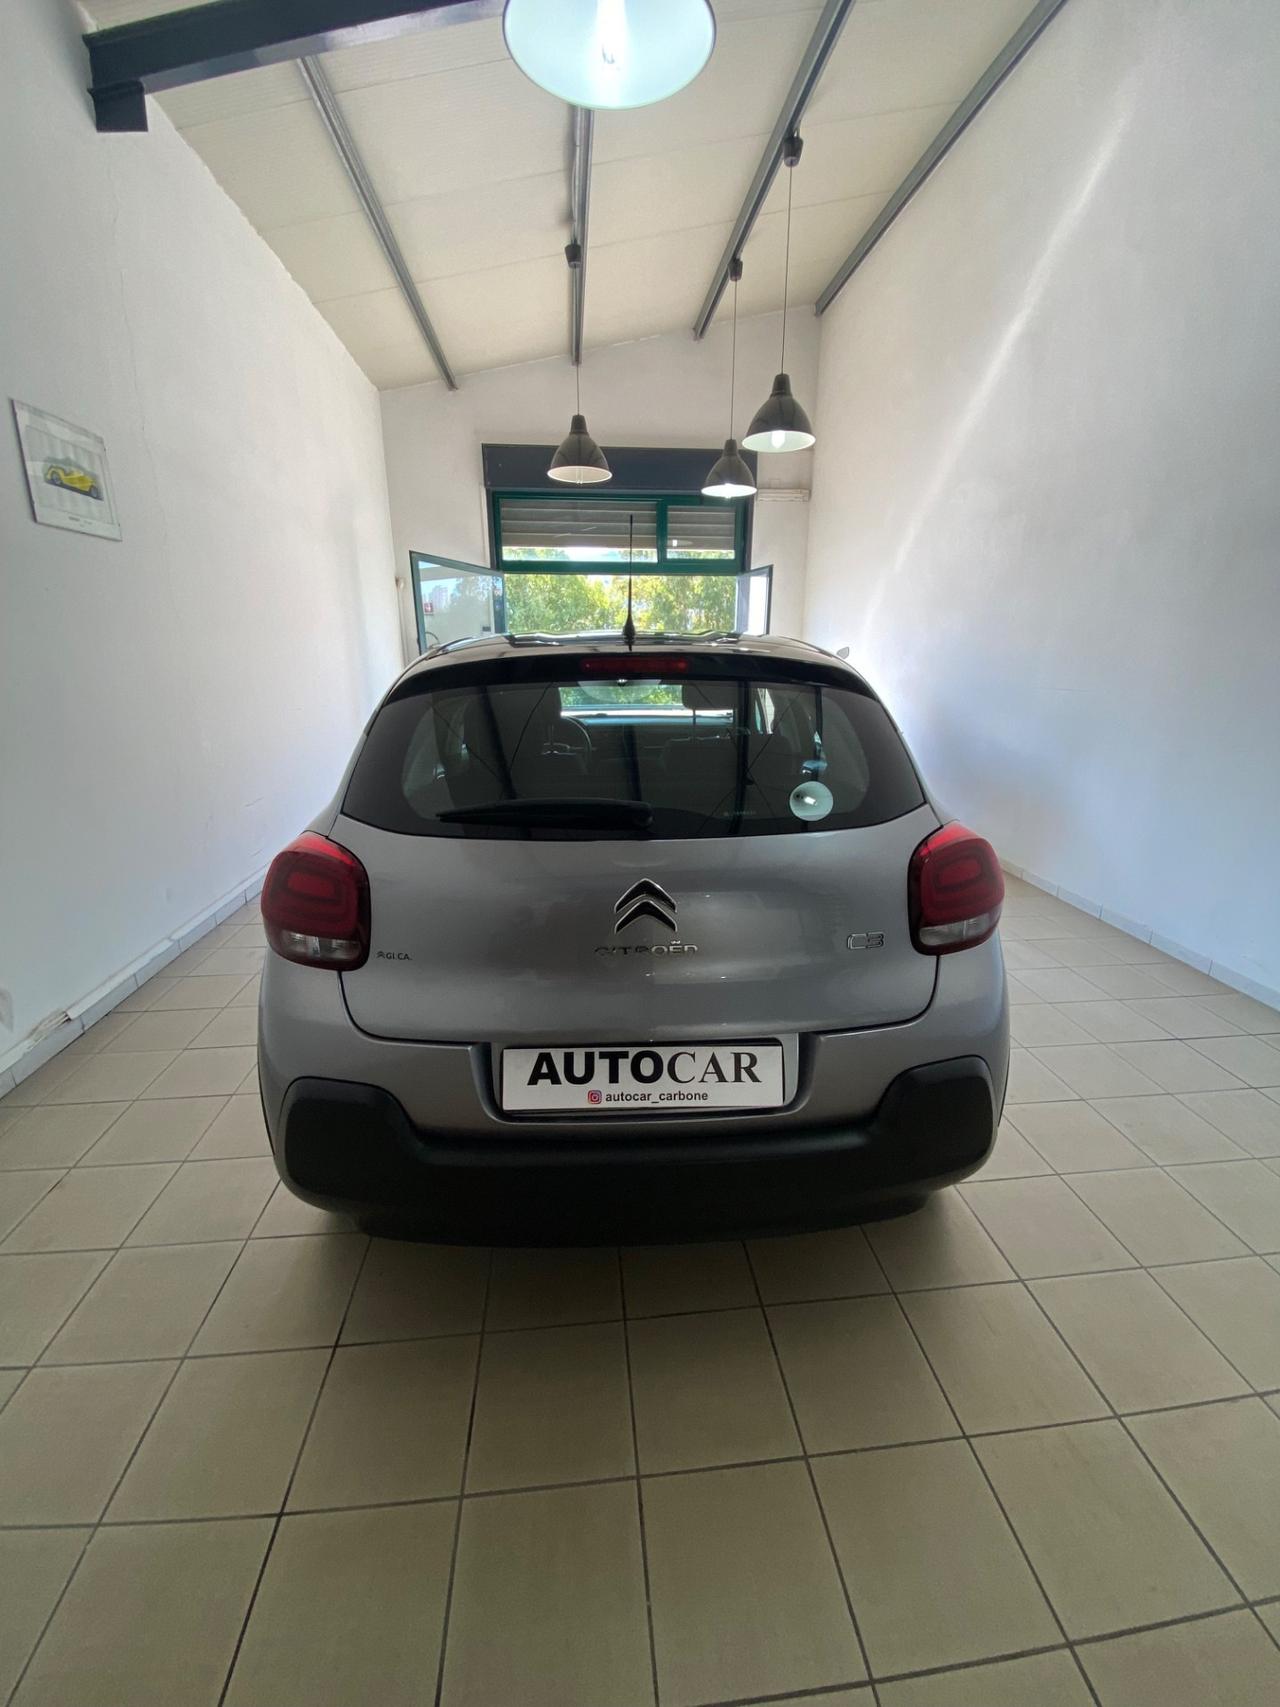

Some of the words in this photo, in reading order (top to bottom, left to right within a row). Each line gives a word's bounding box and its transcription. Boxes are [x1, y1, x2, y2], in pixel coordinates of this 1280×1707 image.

[847, 931, 884, 949] C3
[527, 1051, 762, 1085] AUTOCAR
[605, 1091, 708, 1103] autocar_carbone
